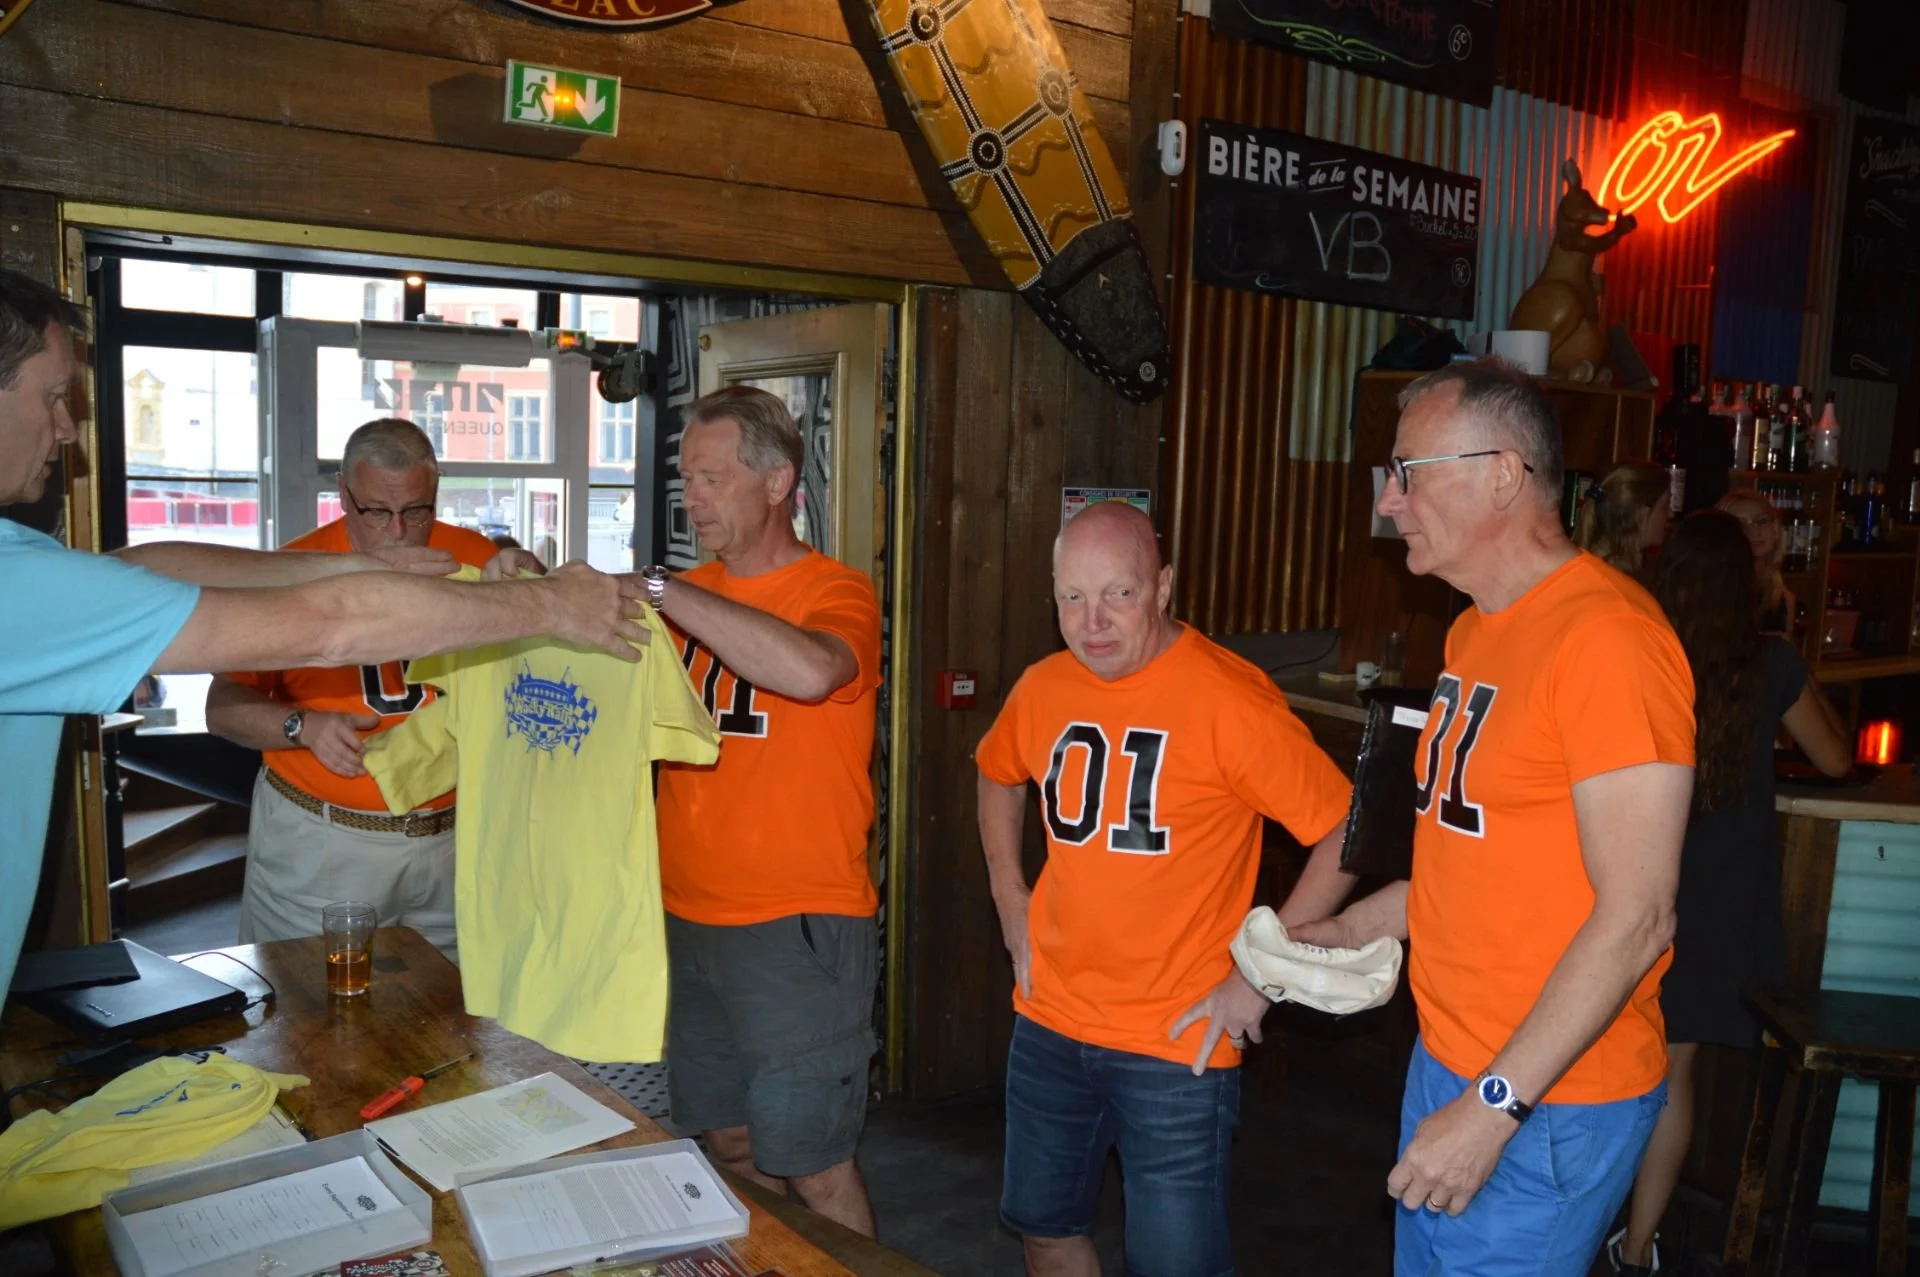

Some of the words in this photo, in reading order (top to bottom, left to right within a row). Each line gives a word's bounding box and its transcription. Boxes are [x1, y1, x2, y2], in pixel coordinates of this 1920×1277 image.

[1208, 135, 1300, 188] BIÈRE
[1308, 168, 1326, 186] de
[1331, 166, 1346, 183] la
[1352, 165, 1477, 224] SEMAINE
[1308, 210, 1392, 281] VB
[1044, 721, 1170, 854] 01
